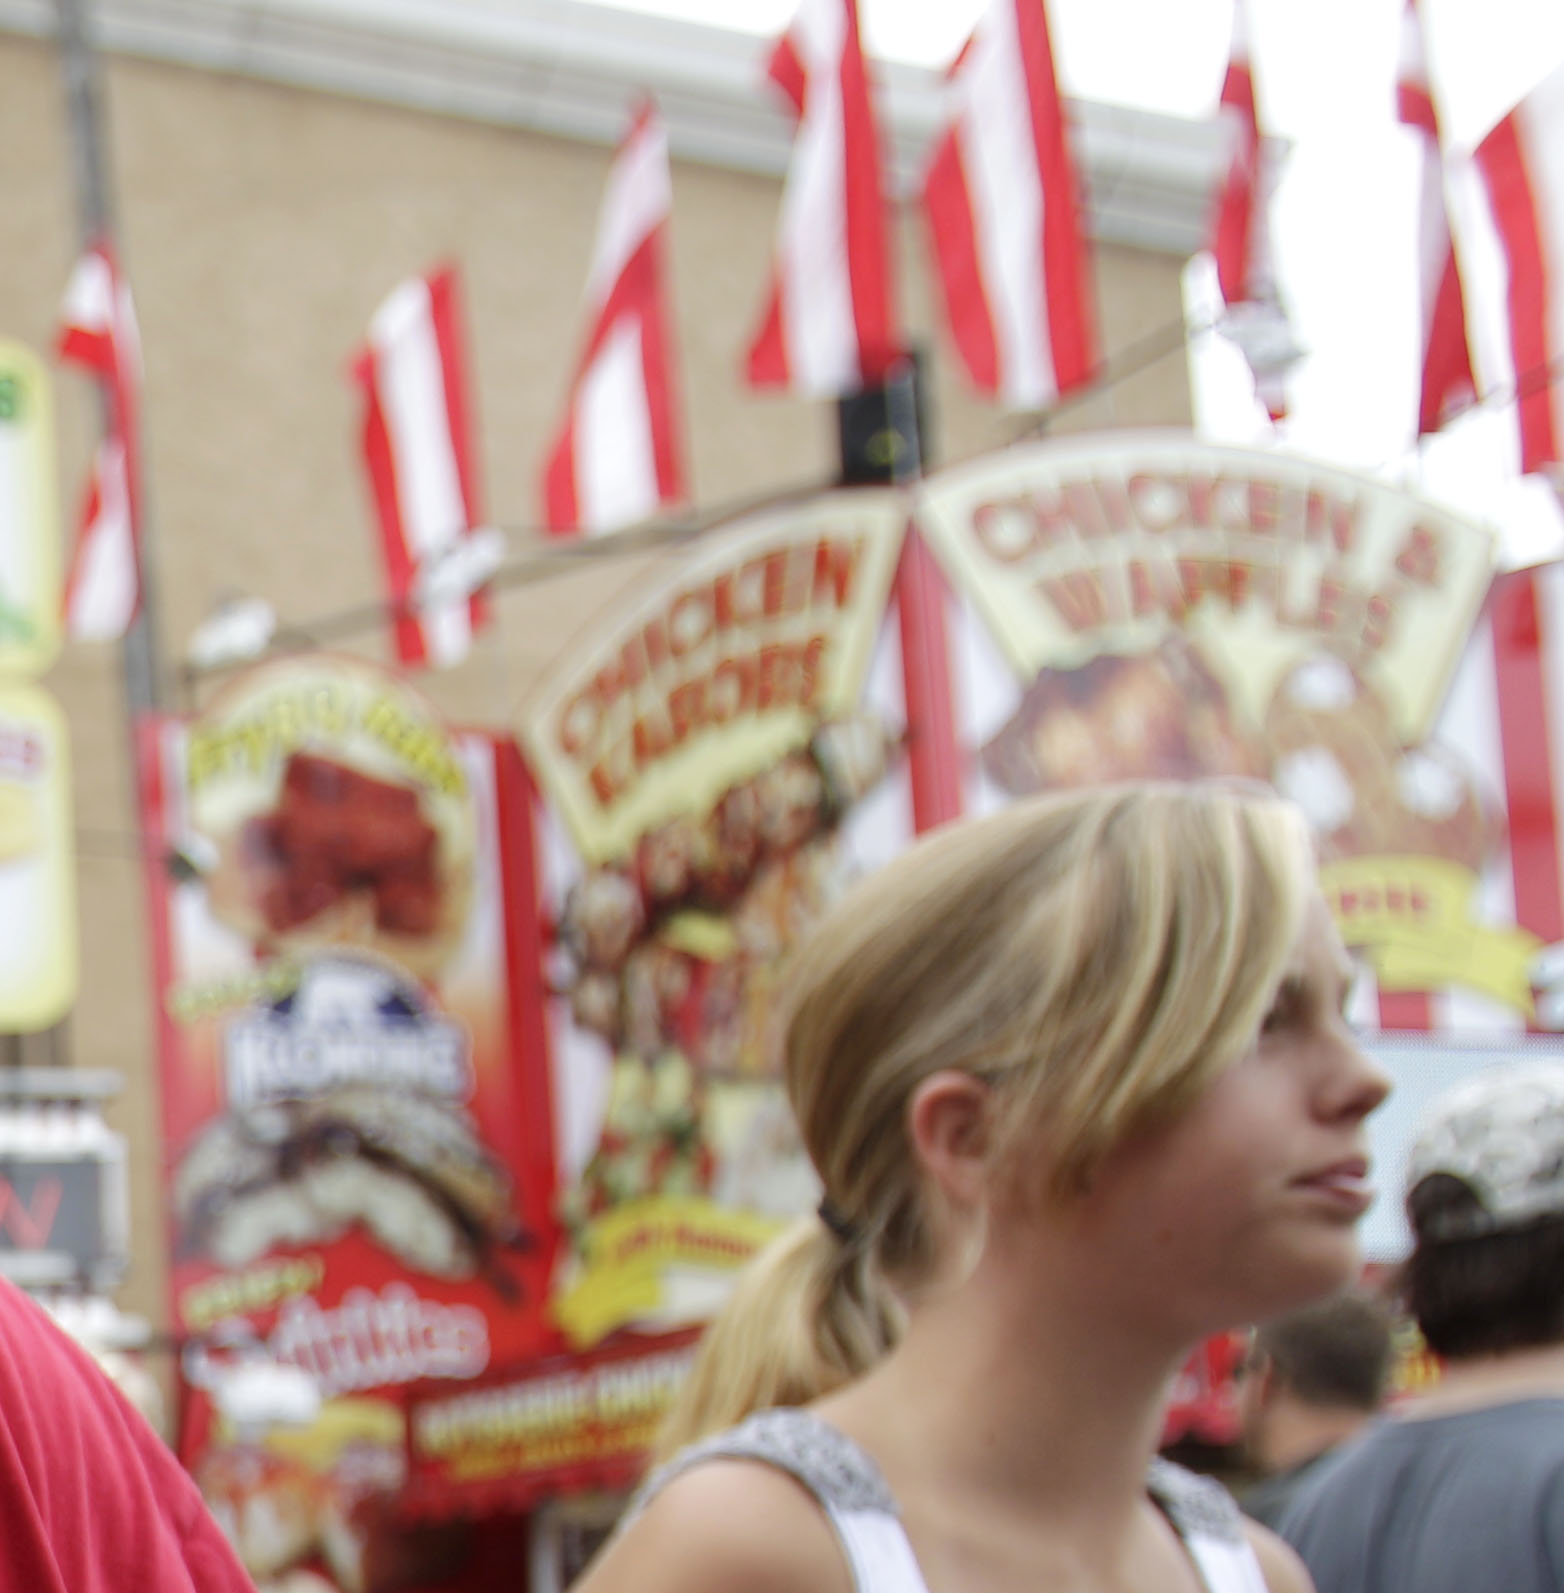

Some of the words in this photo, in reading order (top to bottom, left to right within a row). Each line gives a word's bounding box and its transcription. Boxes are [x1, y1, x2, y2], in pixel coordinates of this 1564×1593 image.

[973, 473, 1361, 561] CHICKEN
[1395, 522, 1440, 584] &
[558, 537, 868, 755] CHICKEN
[1040, 557, 1394, 648] WAFFLES
